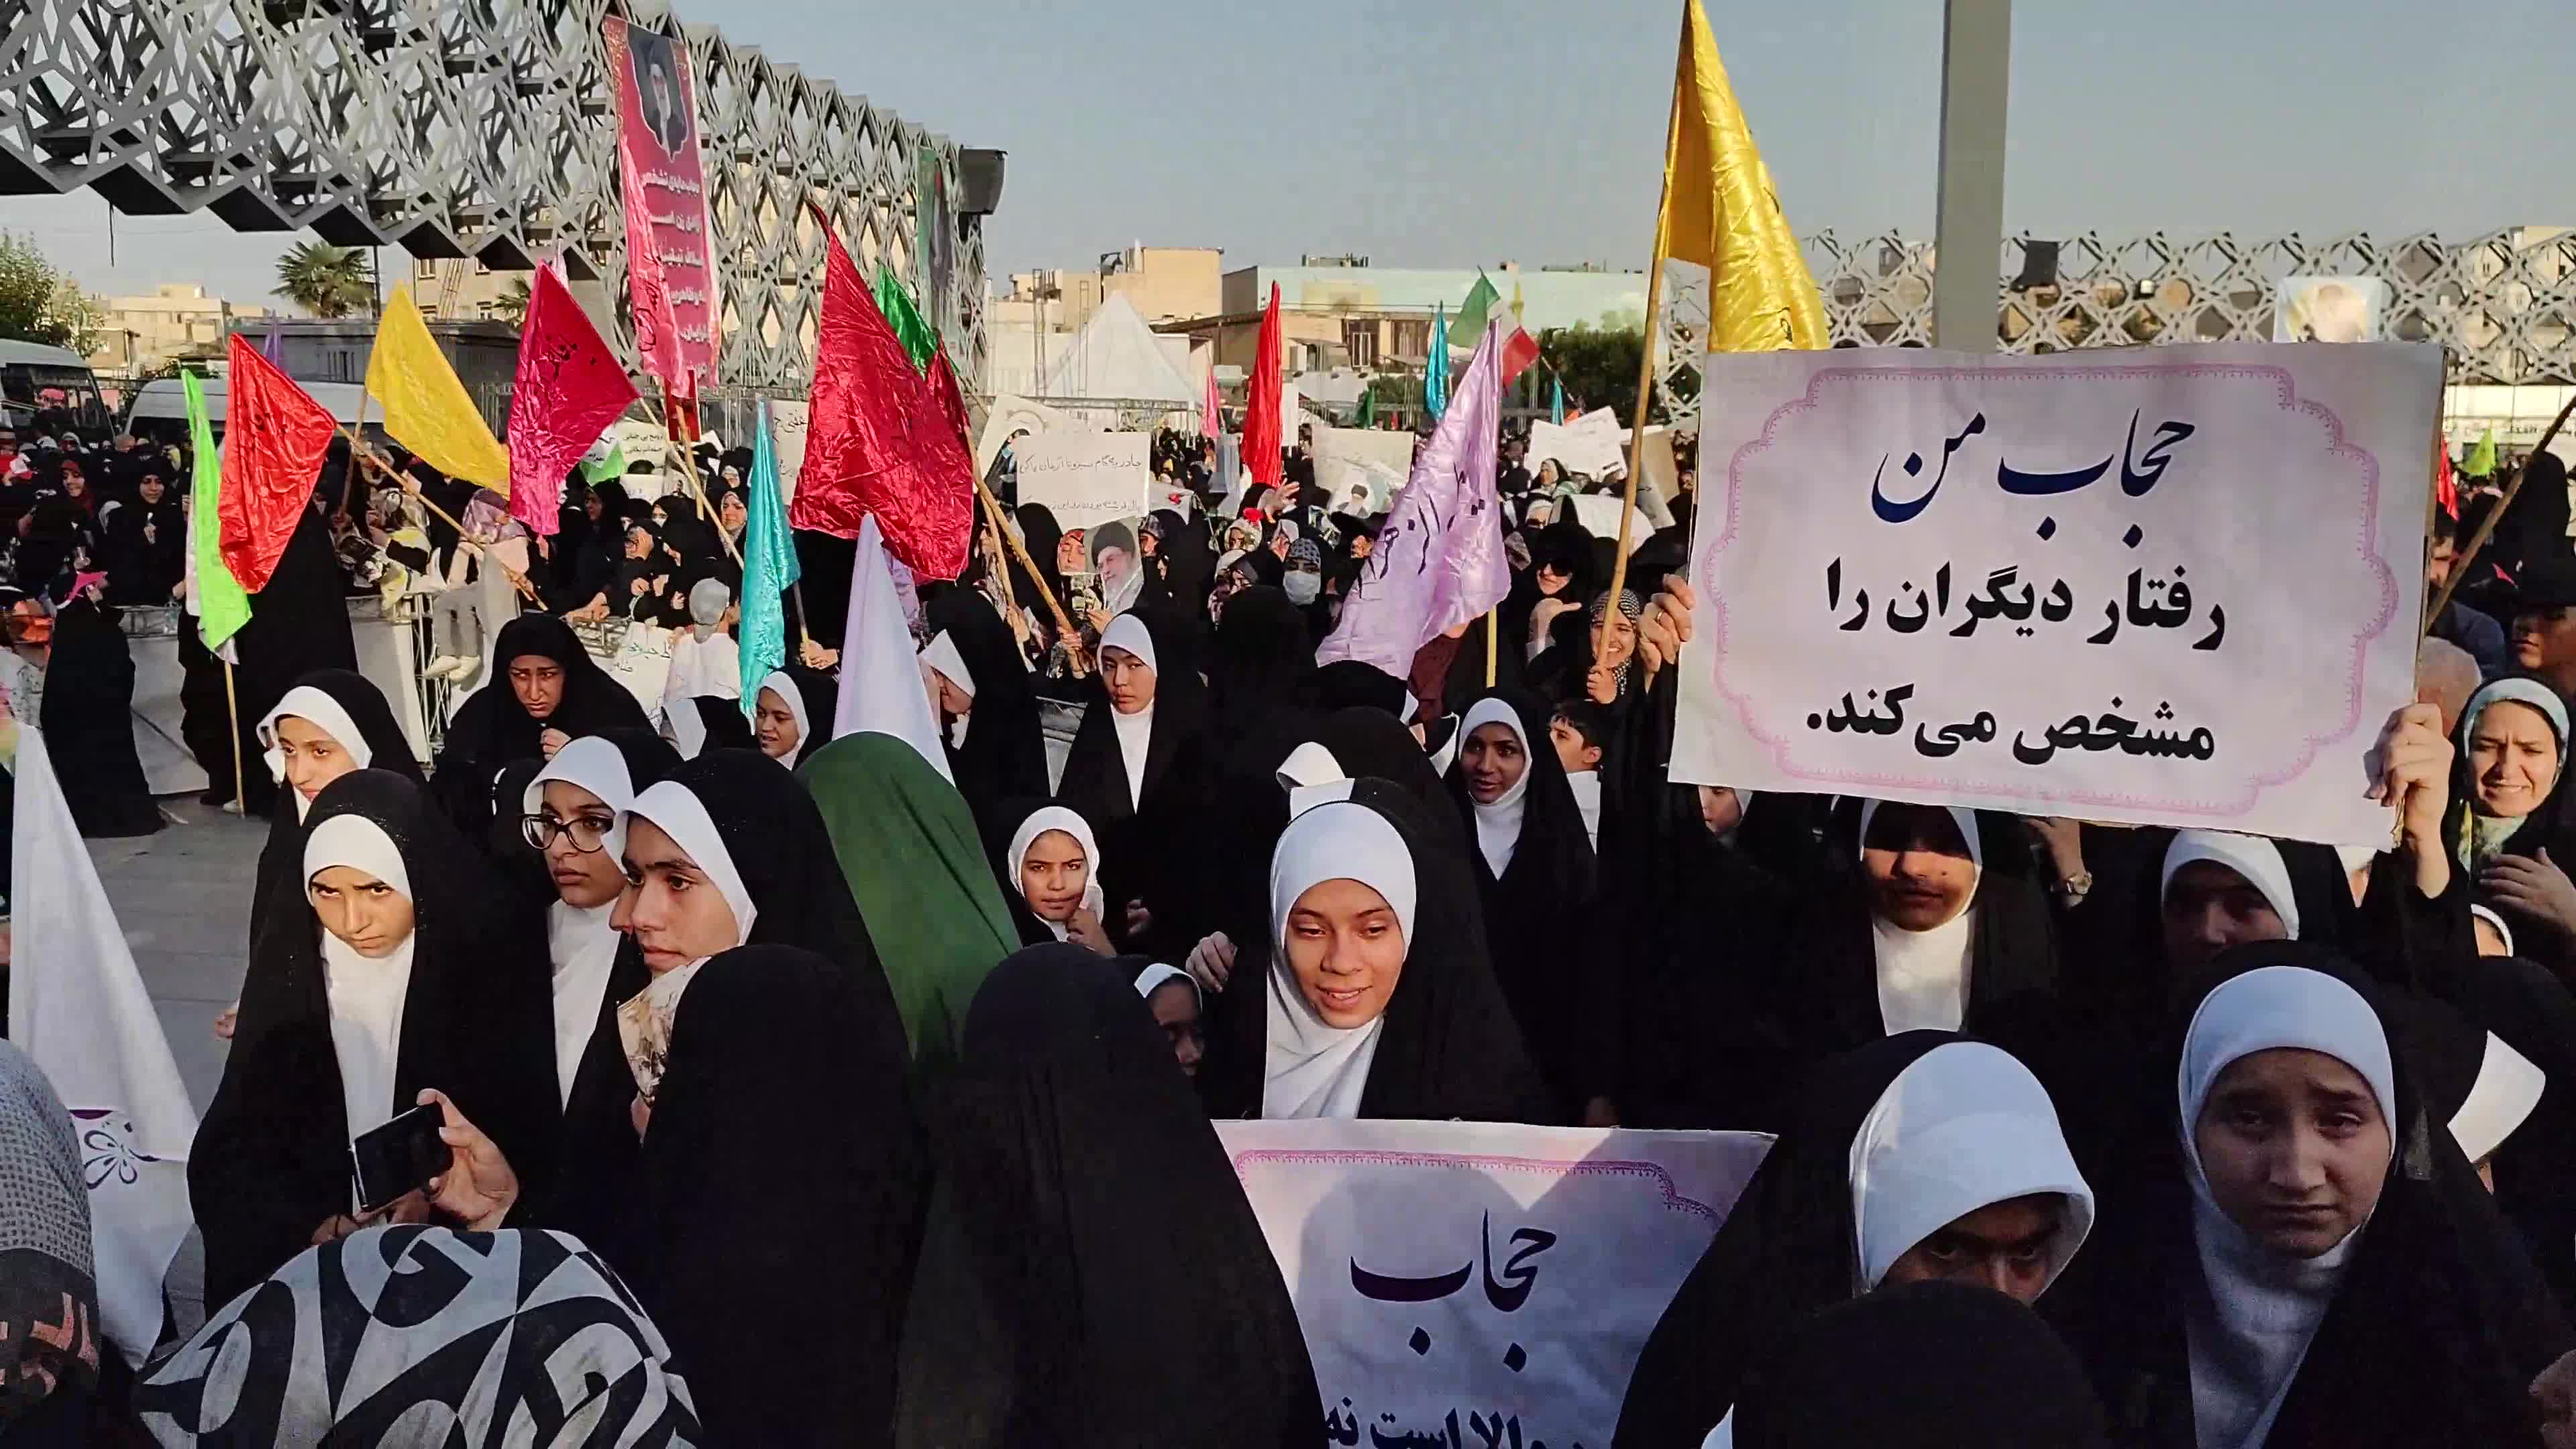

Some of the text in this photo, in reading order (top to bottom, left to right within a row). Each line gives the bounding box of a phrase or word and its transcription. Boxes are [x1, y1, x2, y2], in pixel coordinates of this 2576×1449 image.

[1872, 407, 2196, 549] حجاب من
[1827, 557, 2225, 651] رفتار دیگران را
[2012, 696, 2214, 765] مشخص
[1350, 1209, 1557, 1373] حجاب
